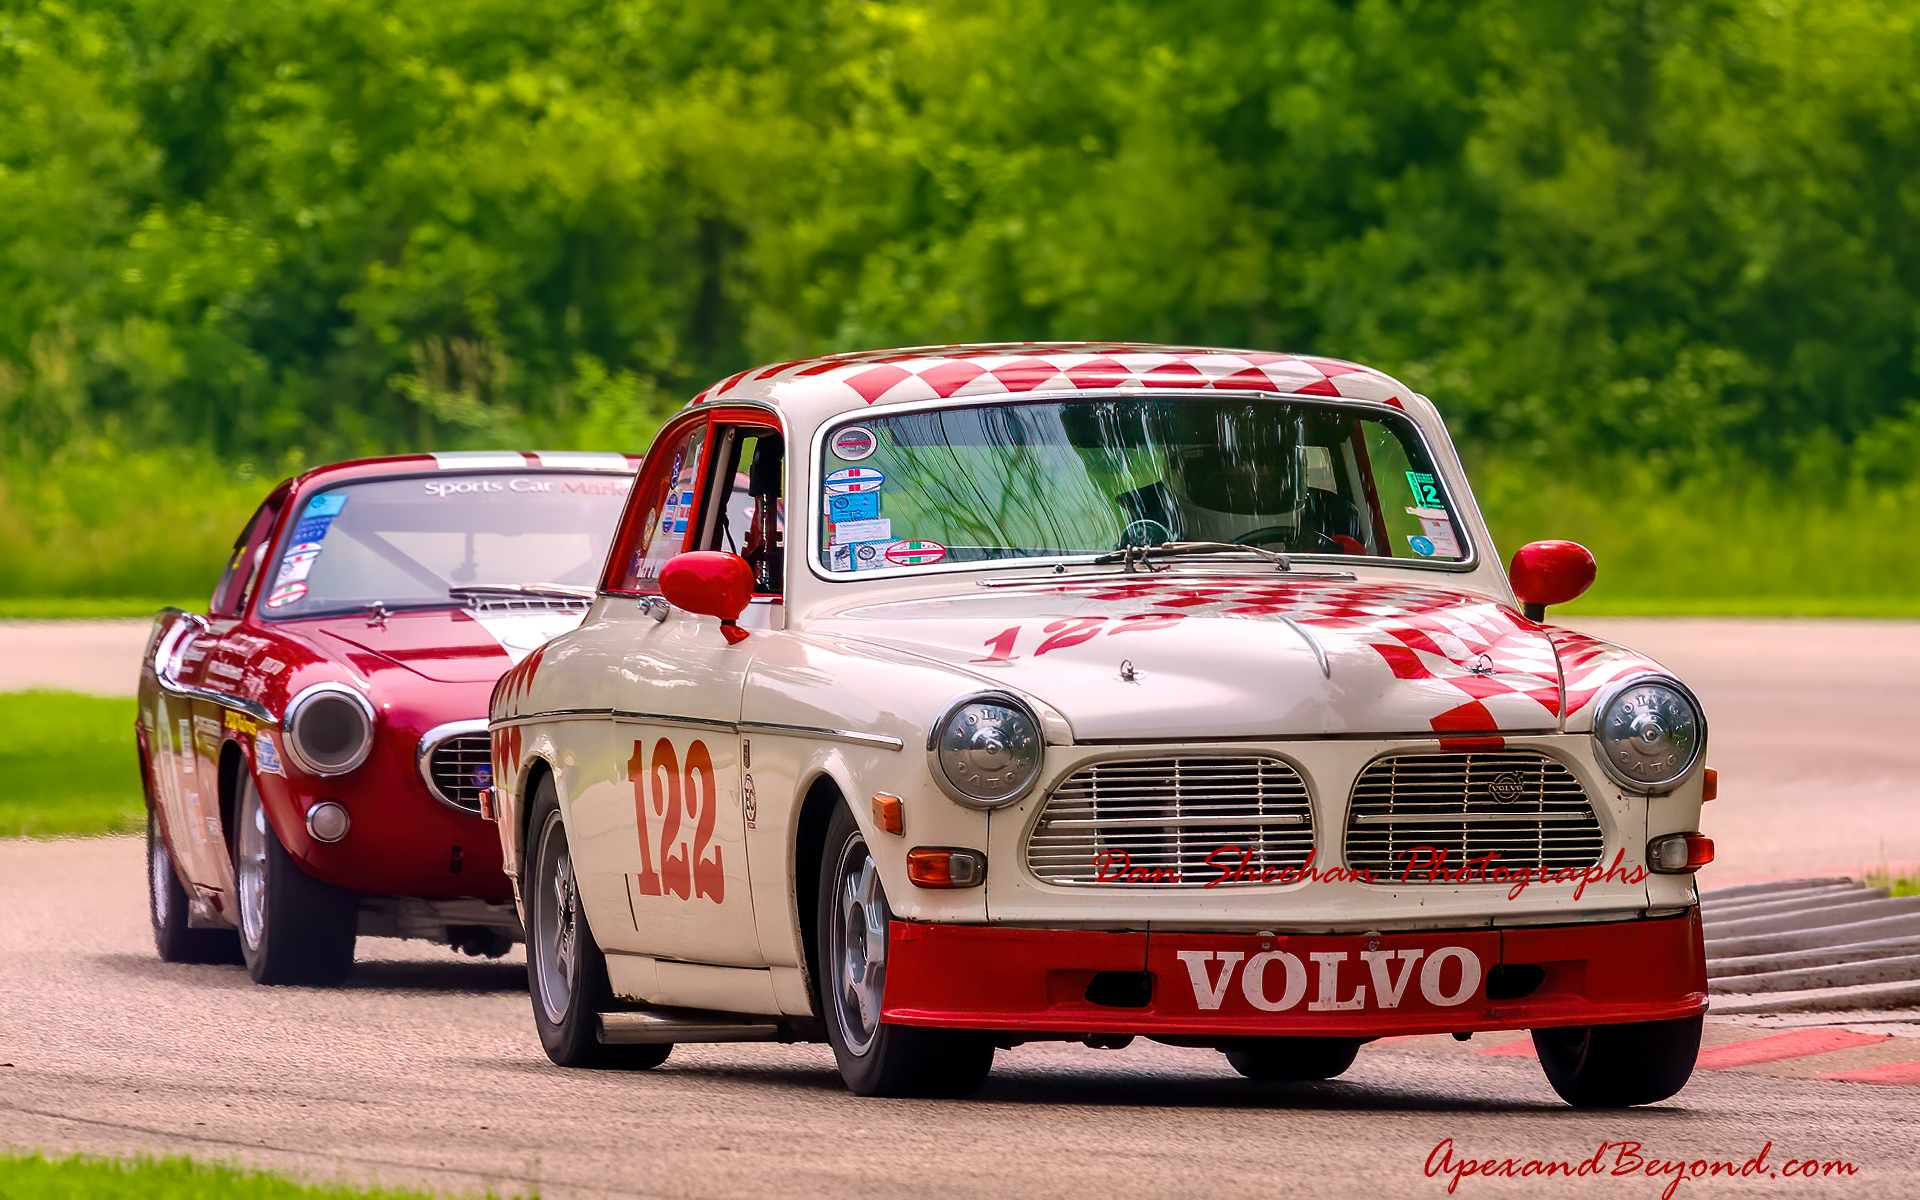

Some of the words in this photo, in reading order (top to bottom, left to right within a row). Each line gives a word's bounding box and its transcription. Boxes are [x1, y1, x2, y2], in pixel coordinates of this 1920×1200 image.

[424, 480, 503, 497] Sports
[509, 478, 551, 492] Car
[968, 613, 1188, 663] 122
[627, 736, 725, 905] 122
[1176, 946, 1482, 1012] VOLVO
